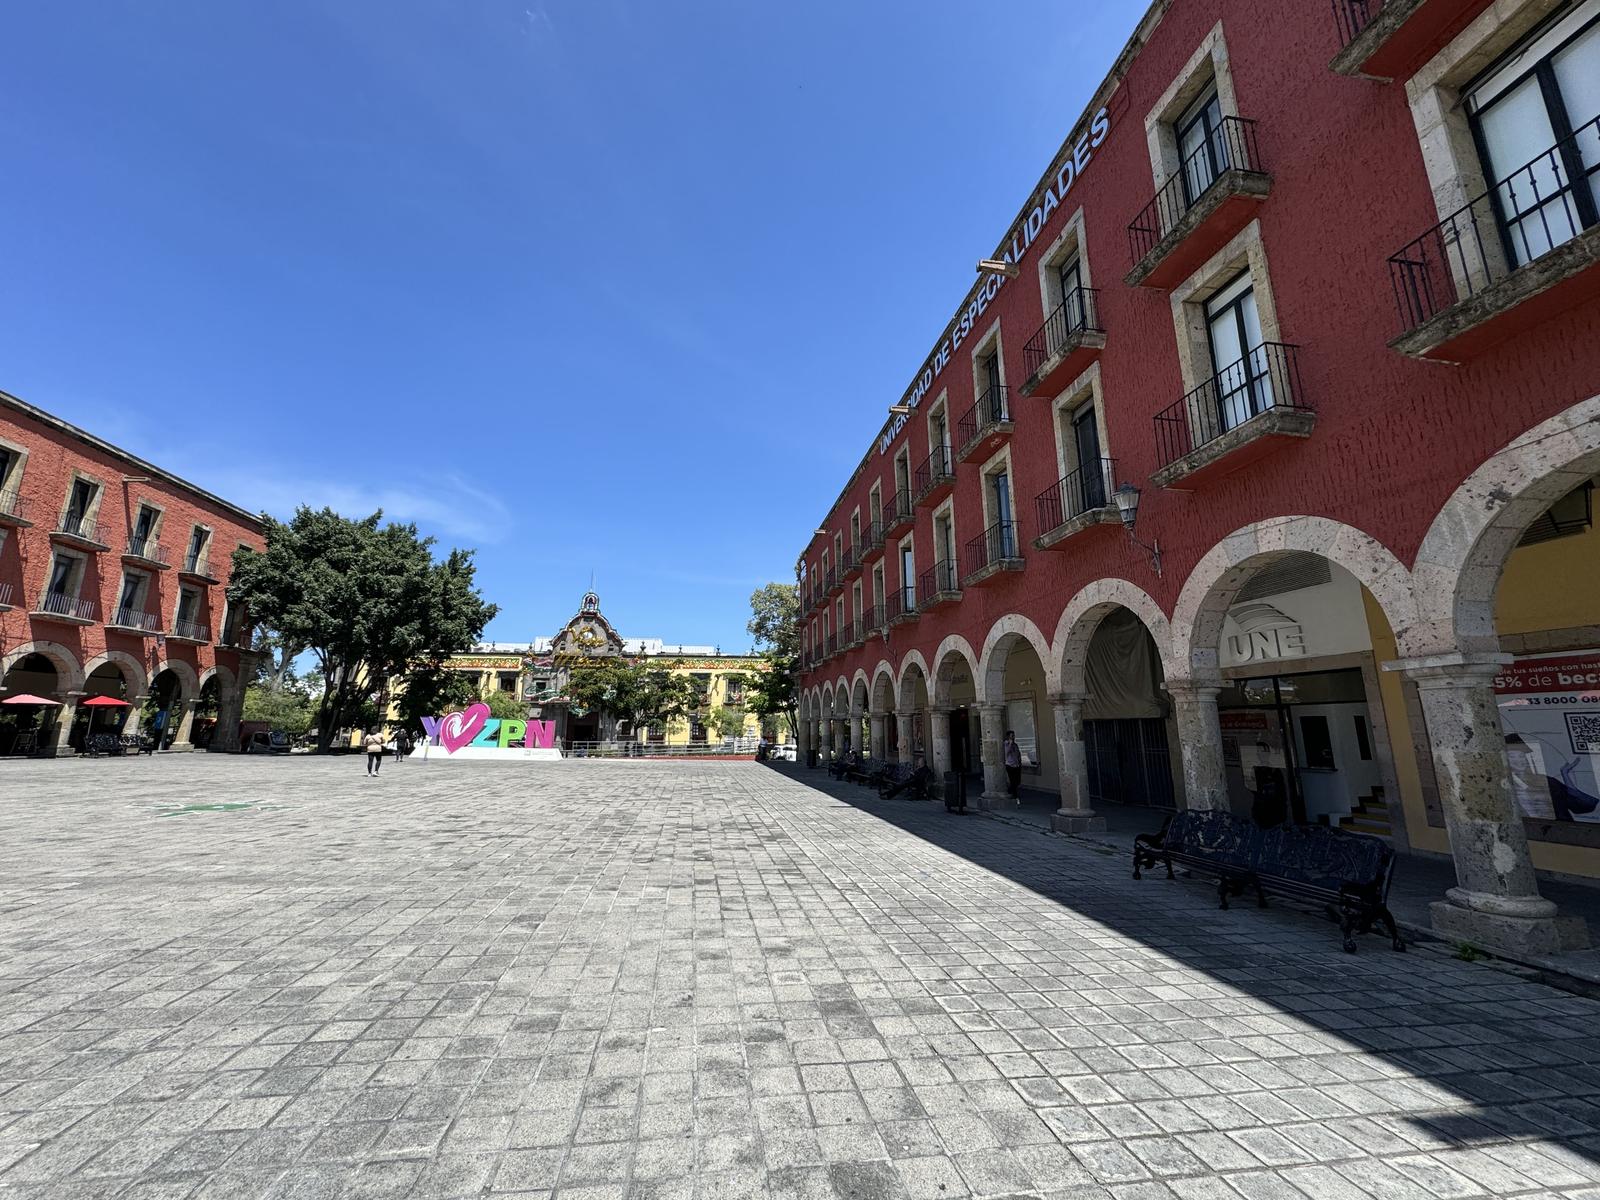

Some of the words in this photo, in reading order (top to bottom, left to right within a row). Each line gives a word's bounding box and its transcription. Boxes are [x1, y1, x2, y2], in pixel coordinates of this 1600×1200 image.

[934, 339, 950, 377] DE
[1228, 625, 1306, 662] UNE
[1528, 674, 1553, 687] de
[1557, 671, 1600, 685] bec
[1543, 696, 1578, 705] 8000
[1581, 695, 1600, 704] 08
